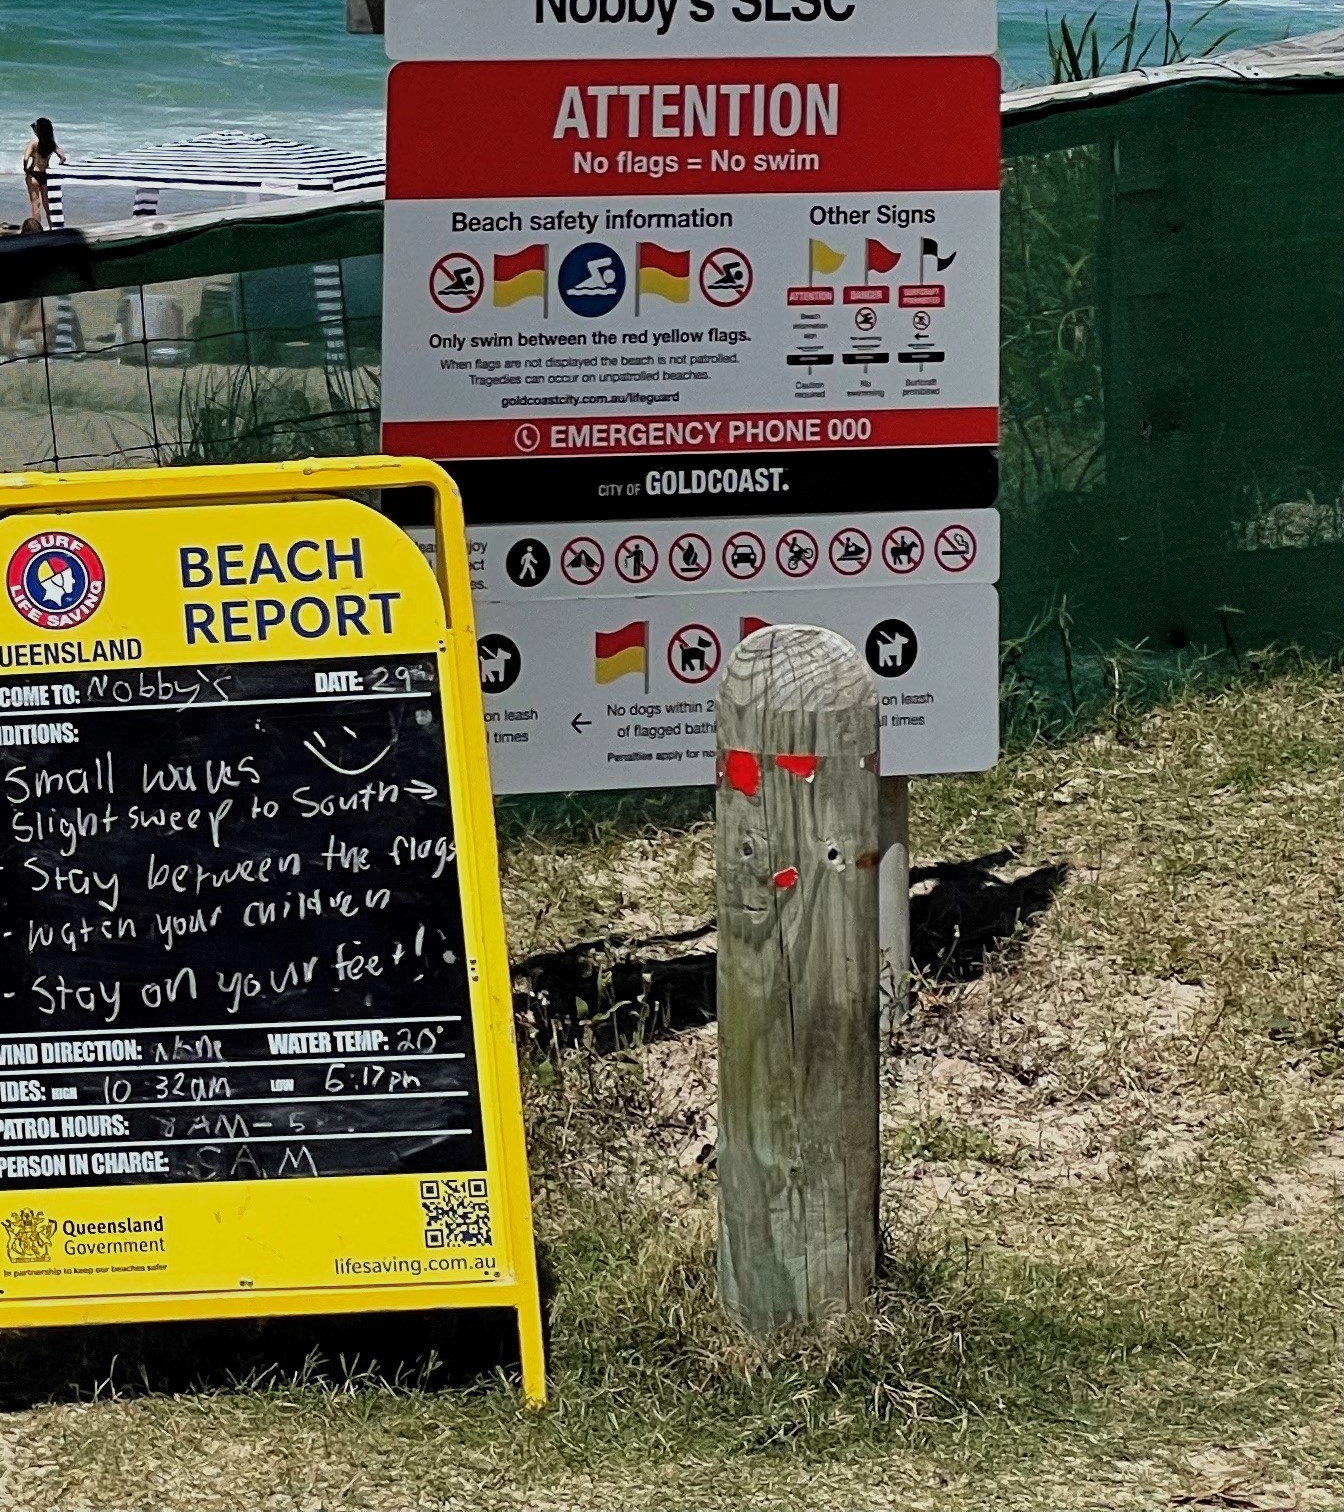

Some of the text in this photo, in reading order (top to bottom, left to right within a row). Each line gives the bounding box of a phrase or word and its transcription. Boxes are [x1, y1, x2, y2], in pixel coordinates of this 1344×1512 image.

[552, 82, 840, 139] ATTENTION
[572, 152, 609, 175] No
[615, 149, 679, 179] flags
[710, 149, 747, 174] No
[752, 149, 821, 173] swim
[451, 207, 733, 237] Beach safety information
[809, 204, 936, 230] Other Signs
[428, 327, 752, 352] Only swim between the red yellow flags.
[440, 353, 740, 371] When flags are not displayed the beach is not patrolled.
[468, 369, 712, 387] Tragedies can occur on unpatrolled beaches.
[500, 391, 680, 408] goldcoastcity.com.au/lifeguard
[549, 416, 873, 449] EMERGENCY PHONE 000
[598, 484, 623, 498] CITY
[626, 483, 642, 496] OF
[27, 535, 84, 553] SURF
[179, 537, 365, 589] BEACH
[10, 580, 103, 627] LIFE SAVING
[184, 592, 402, 645] REPORT
[314, 671, 364, 693] DATE:
[49, 683, 81, 706] TO:
[881, 691, 934, 706] on leash
[483, 707, 539, 723] on leash
[606, 703, 627, 717] No
[629, 702, 662, 718] dogs
[664, 701, 703, 714] within
[891, 714, 926, 727] times
[493, 731, 529, 744] times
[617, 724, 631, 738] of
[634, 722, 682, 740] flagged
[606, 751, 653, 762] Penalties
[655, 750, 684, 762] apply
[685, 748, 700, 759] for
[4, 750, 113, 804] Small
[12, 779, 399, 856] Slight sweep to South
[23, 834, 456, 911] Stay between the flags
[157, 906, 223, 951] your
[243, 888, 391, 929] children
[31, 974, 121, 1022] Stay
[141, 966, 198, 1009] on
[218, 956, 319, 1014] your
[40, 1039, 143, 1064] DIRECTION:
[267, 1029, 390, 1055] WATER TEMP:
[270, 1078, 295, 1092] LOW
[61, 1113, 130, 1138] HOURS:
[68, 1153, 89, 1176] IN
[90, 1150, 170, 1175] CHARGE:
[62, 1215, 164, 1237] Queensland
[63, 1236, 166, 1256] Government
[13, 1267, 62, 1278] partnership
[63, 1267, 72, 1275] to
[73, 1266, 94, 1276] keep
[334, 1254, 497, 1276] lifesaving.com.au
